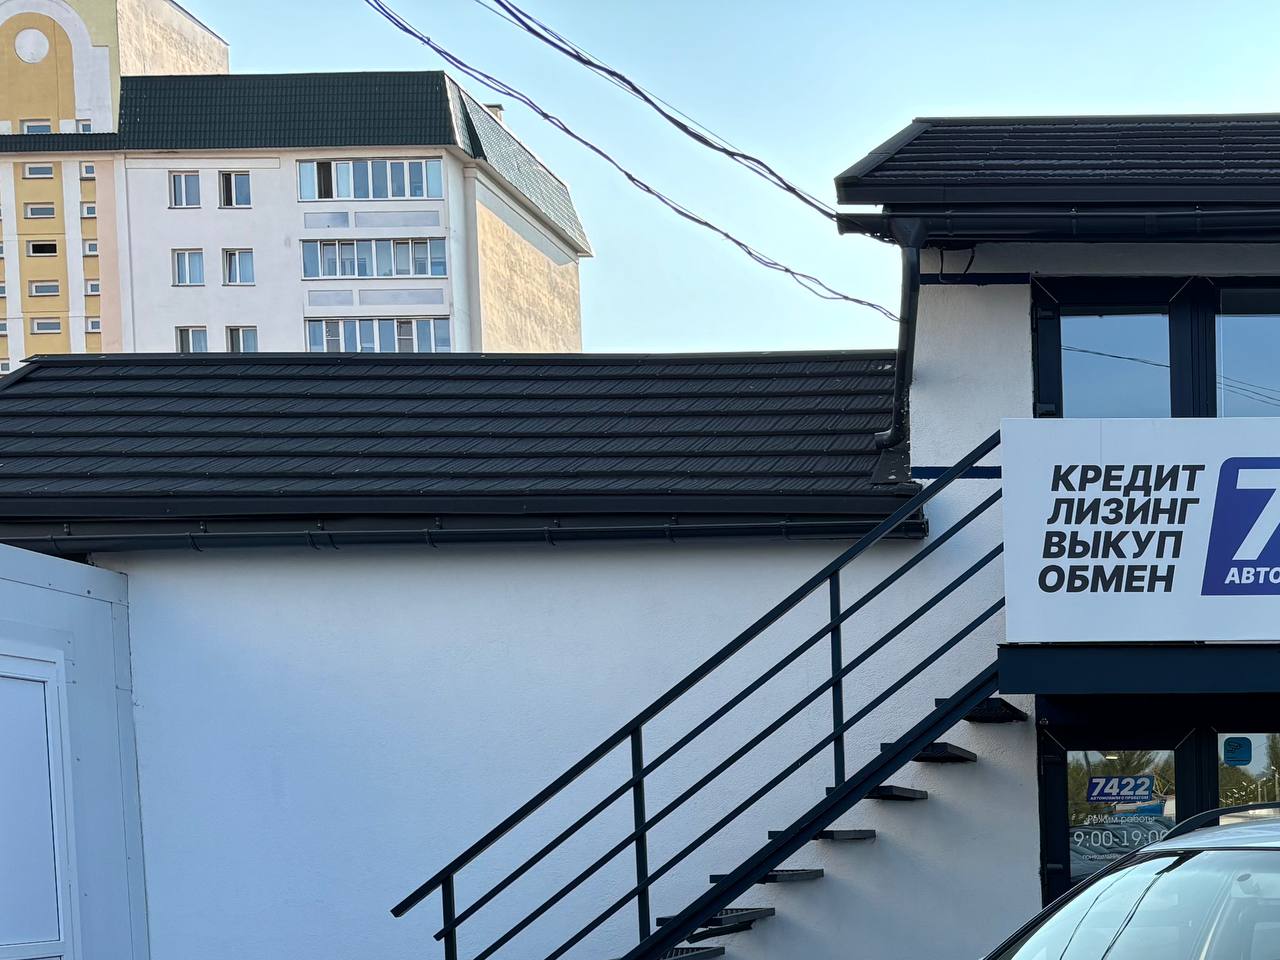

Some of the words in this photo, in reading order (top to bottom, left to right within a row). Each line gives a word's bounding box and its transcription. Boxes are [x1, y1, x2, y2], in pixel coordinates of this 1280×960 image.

[1051, 464, 1206, 498] КРЕДИТ
[1046, 497, 1201, 525] ЛИЗИНГ
[1042, 530, 1184, 559] ВЫКУП
[1038, 565, 1175, 593] ОБМЕН
[1092, 777, 1151, 796] 7422
